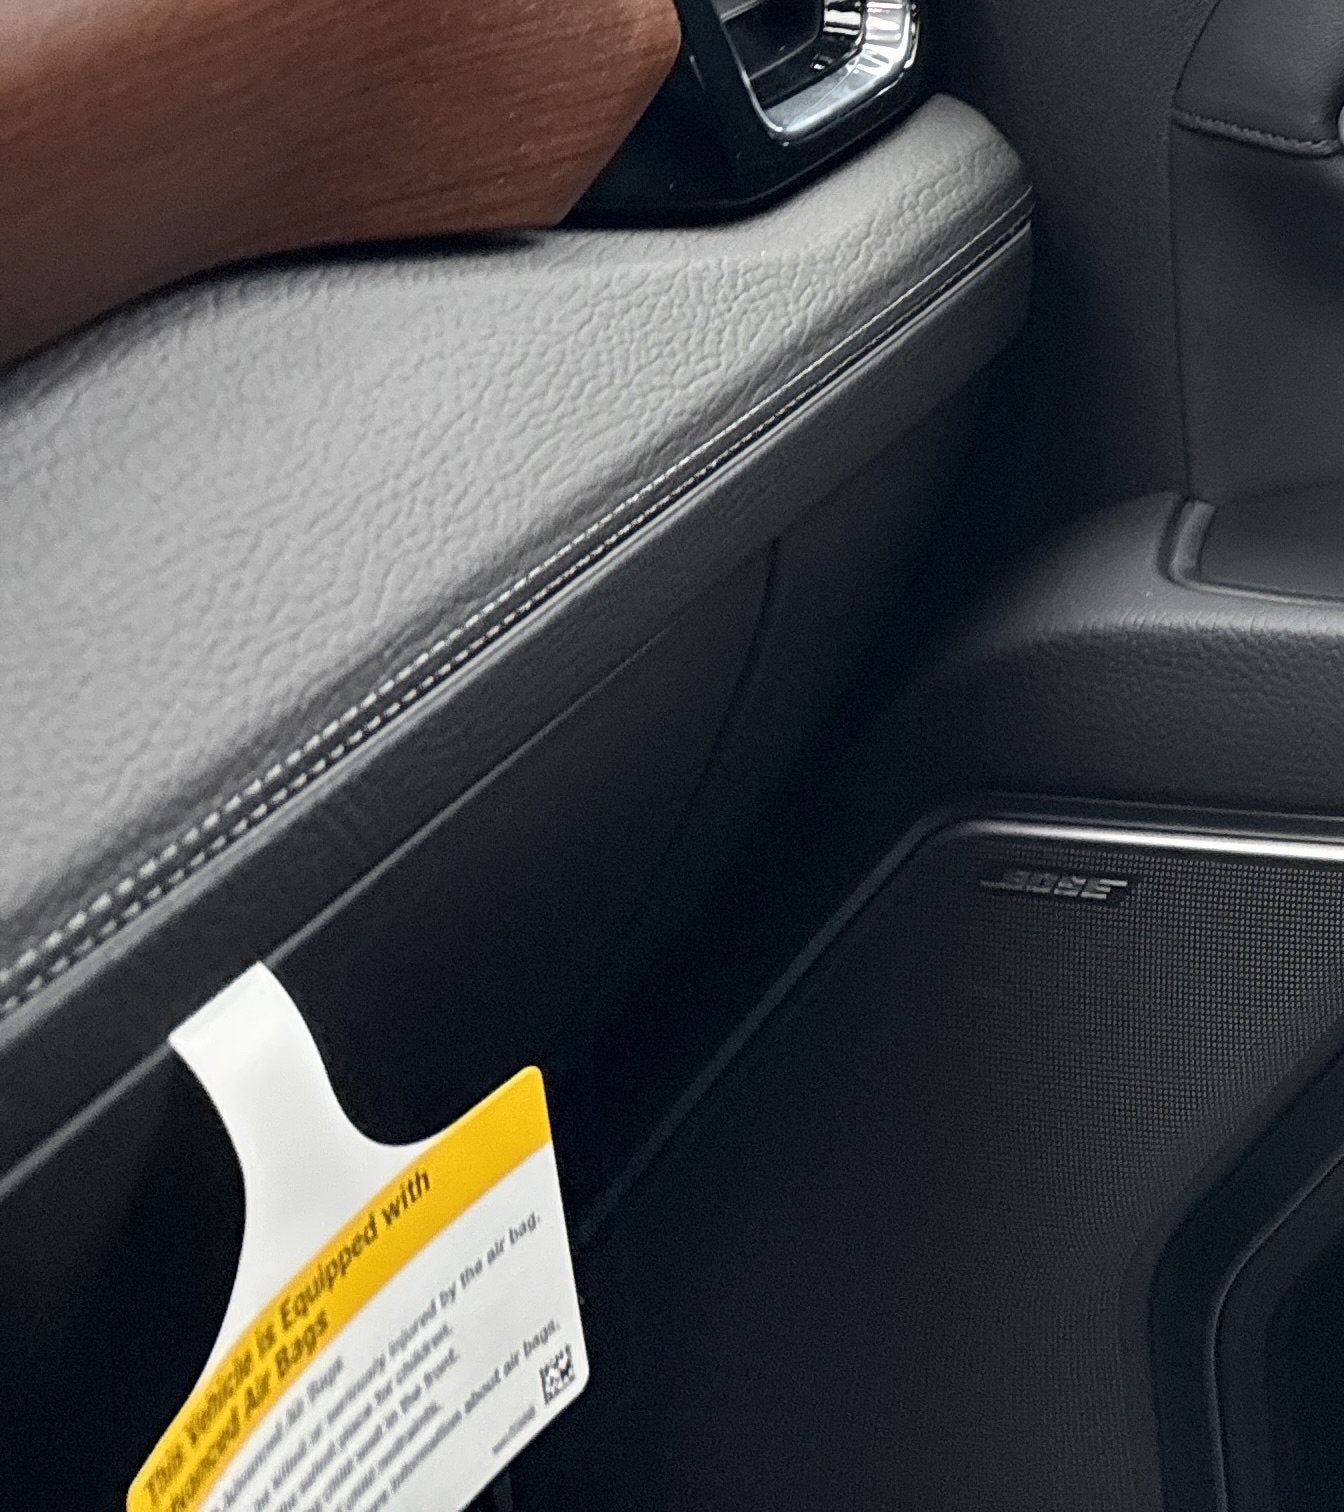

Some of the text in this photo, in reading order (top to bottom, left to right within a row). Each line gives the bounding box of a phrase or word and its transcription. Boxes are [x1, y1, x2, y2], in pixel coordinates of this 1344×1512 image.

[184, 1351, 253, 1449] Vehicle
[279, 1212, 379, 1332] Equipped
[381, 1170, 431, 1227] with
[439, 1281, 457, 1308] by
[460, 1258, 483, 1289] the
[486, 1237, 505, 1266] air
[508, 1211, 541, 1245] bag.
[245, 1367, 271, 1418] Air
[275, 1309, 329, 1379] Bags
[503, 1350, 520, 1377] air
[523, 1319, 561, 1359] bags.
